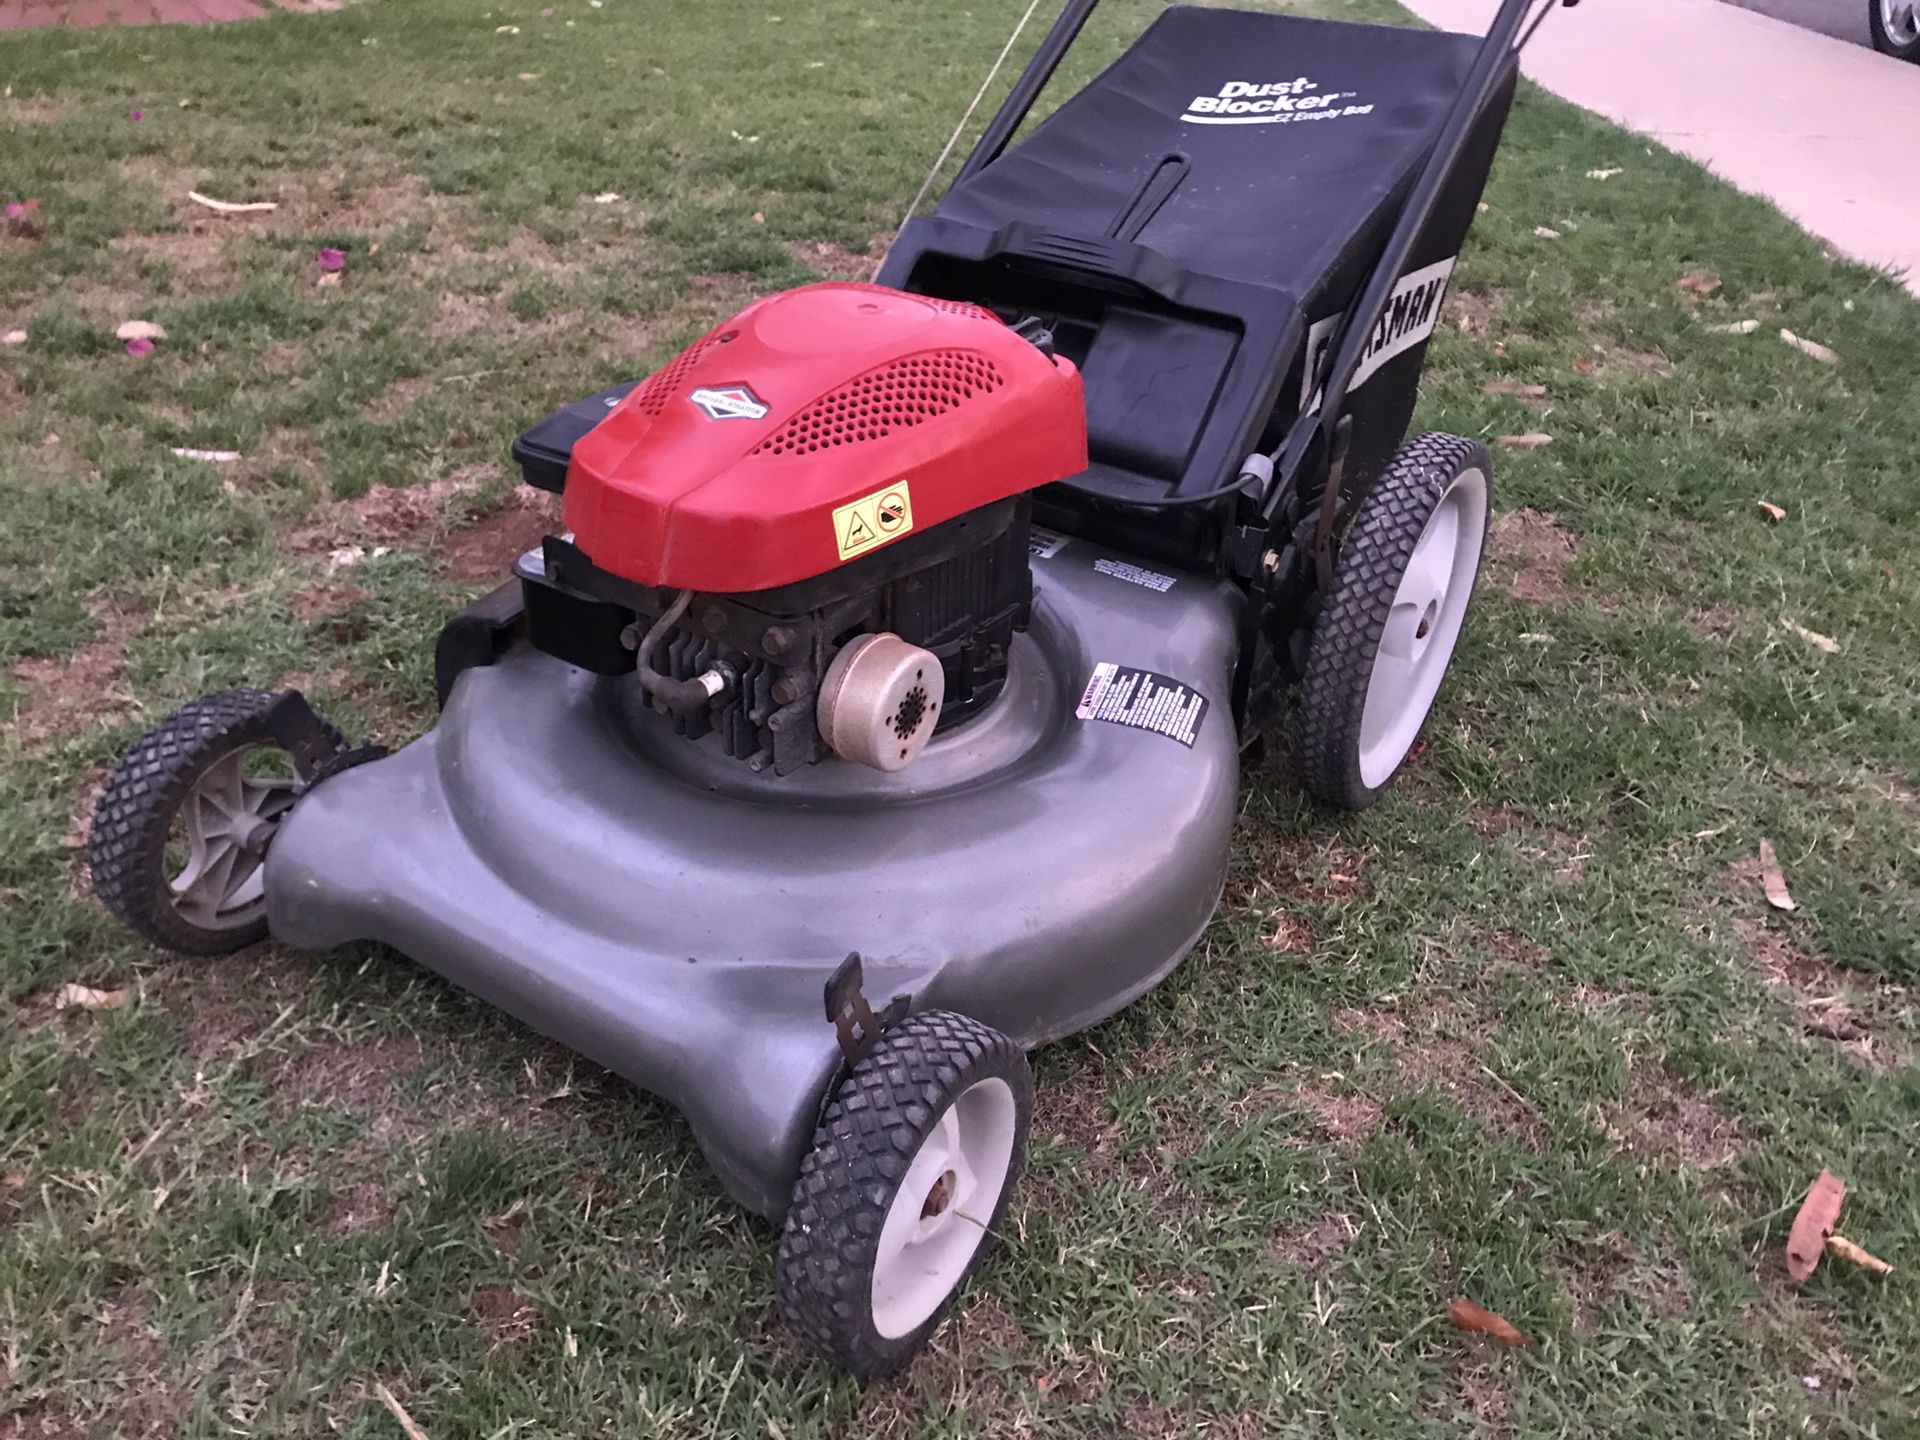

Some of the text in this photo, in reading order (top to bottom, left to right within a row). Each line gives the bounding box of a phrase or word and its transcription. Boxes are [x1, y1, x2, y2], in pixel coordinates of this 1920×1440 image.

[1218, 77, 1318, 98] Dust-
[1292, 109, 1342, 121] Empty
[1342, 104, 1375, 116] Bag
